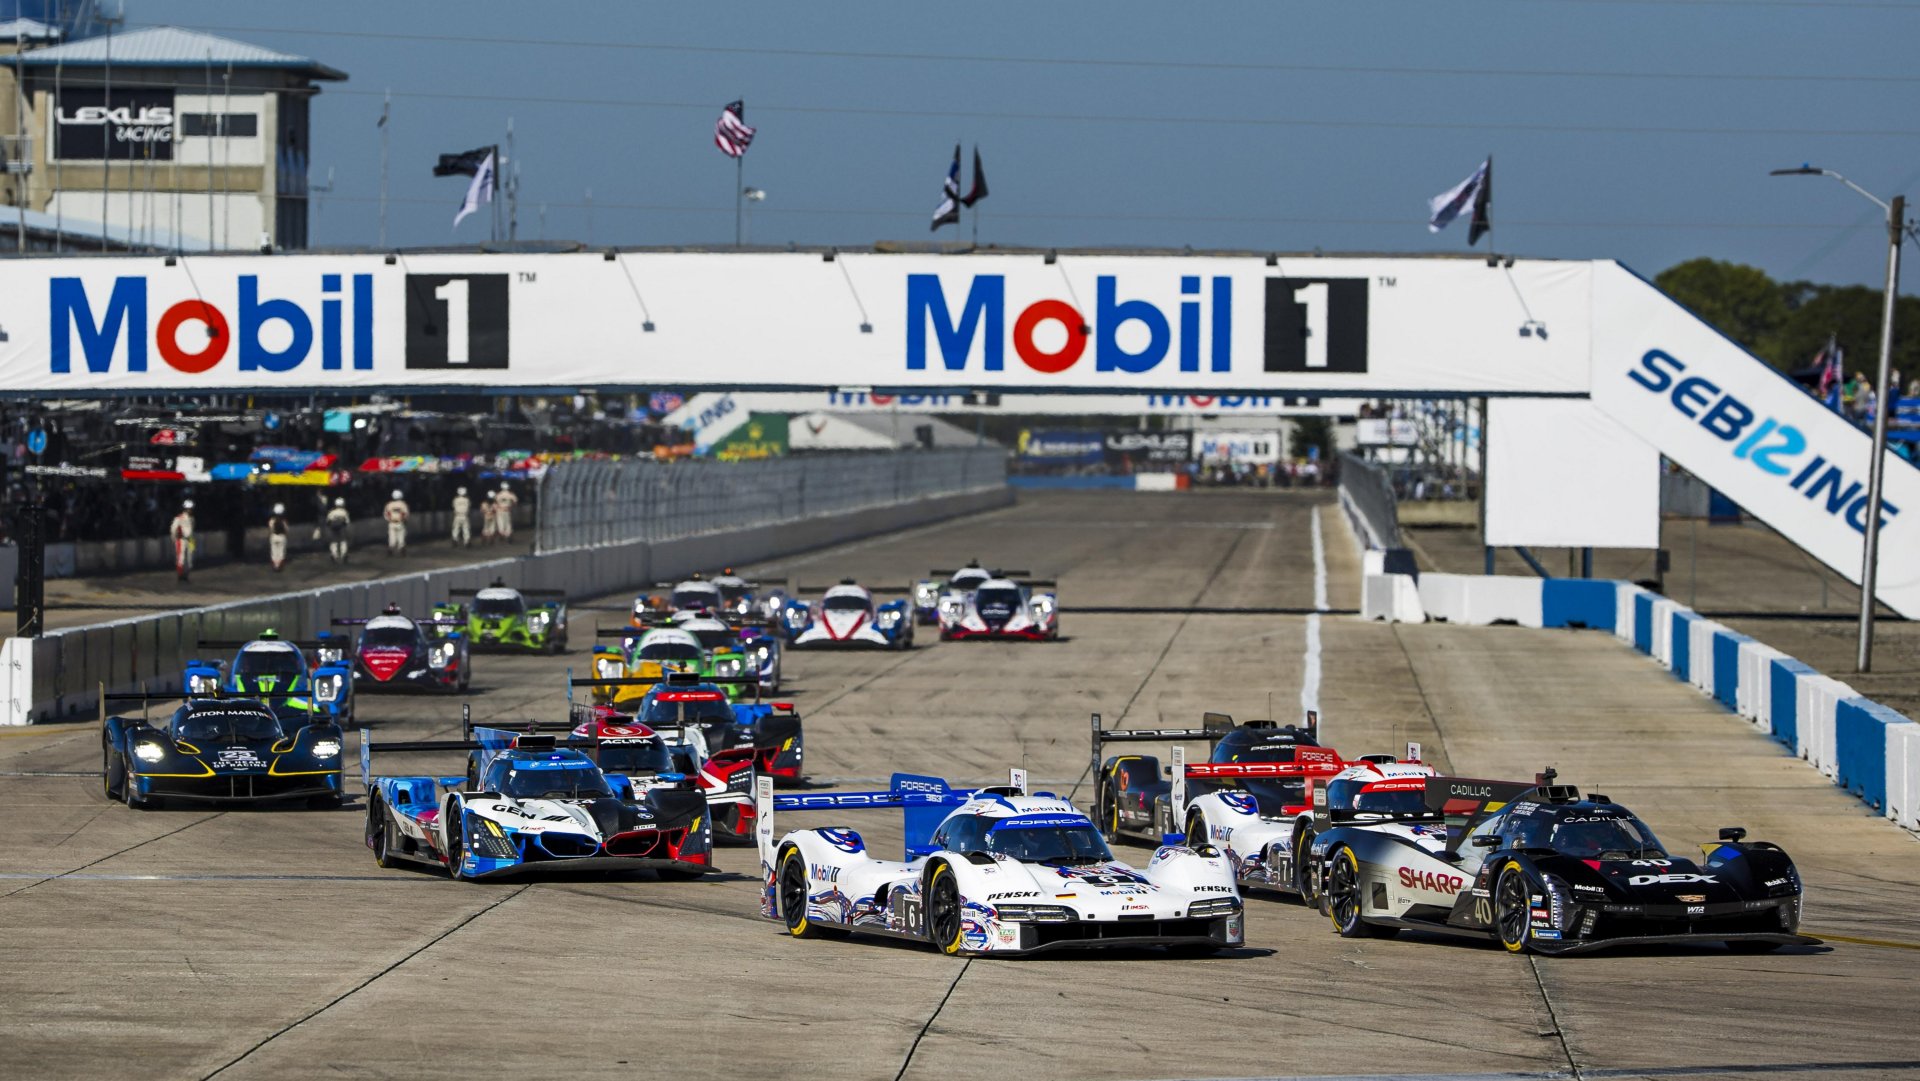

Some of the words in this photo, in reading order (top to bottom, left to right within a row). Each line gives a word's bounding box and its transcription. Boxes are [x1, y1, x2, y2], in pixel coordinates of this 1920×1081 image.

[56, 106, 173, 125] LEXUS
[50, 273, 373, 373] Mobil
[435, 279, 470, 364] 1
[906, 274, 1231, 373] Mobil
[1294, 282, 1329, 367] 1
[188, 710, 225, 720] ASTON
[1251, 744, 1297, 752] PORSC
[1301, 751, 1334, 763] PORSCHE
[900, 780, 942, 794] PORSCHE
[1450, 784, 1492, 798] CADILLAC
[925, 793, 943, 803] 963
[492, 804, 537, 820] GEN
[1006, 818, 1089, 826] PORSCHE
[1210, 824, 1226, 841] Mobil
[1631, 859, 1673, 867] 40
[811, 863, 831, 882] Mobil
[1282, 860, 1288, 882] 7
[1098, 875, 1119, 884] 6
[1398, 866, 1464, 896] SHARP
[1629, 873, 1720, 886] DEX
[1764, 878, 1781, 888] Mobil
[1193, 886, 1233, 894] PENSKE
[1574, 884, 1595, 892] Mobil
[987, 891, 1041, 901] PENSKE
[909, 904, 916, 928] 6
[1474, 897, 1493, 925] 40
[1531, 910, 1548, 918] MOTUL
[1687, 906, 1705, 914] WTR
